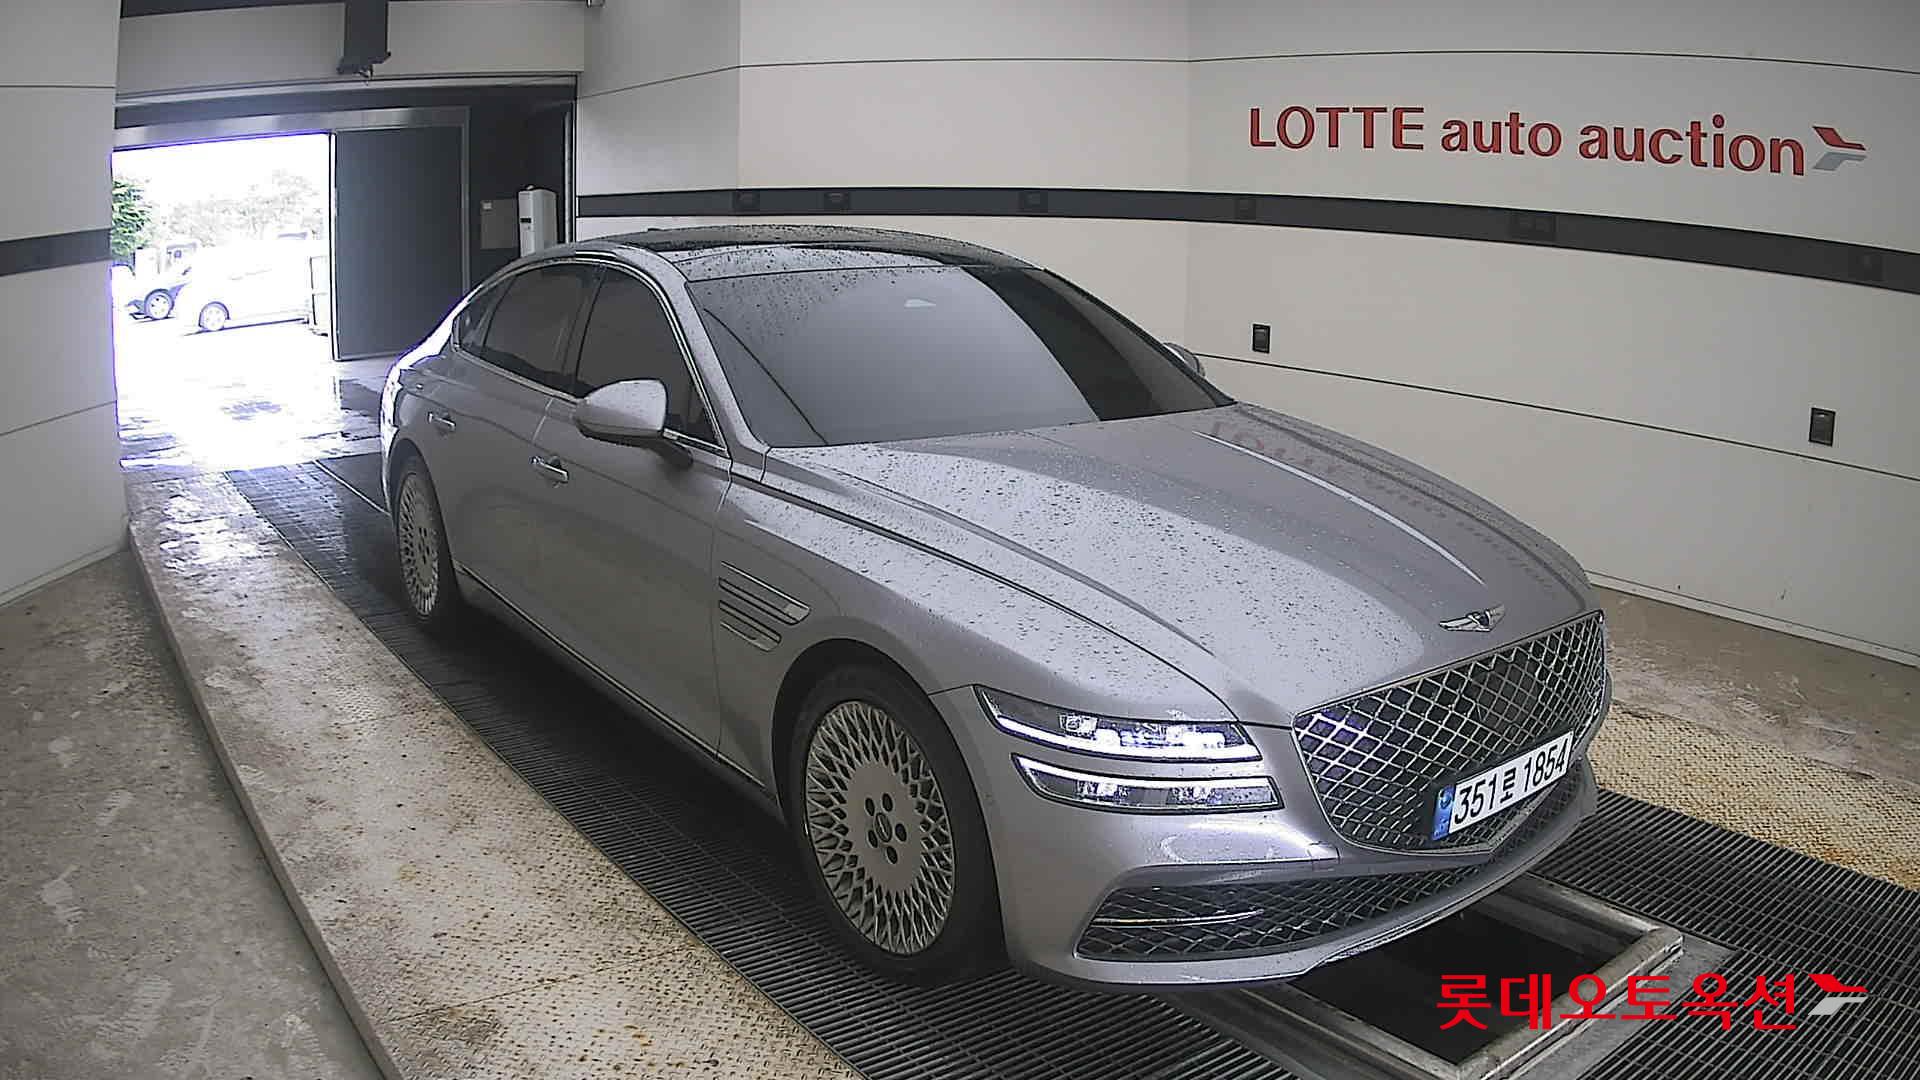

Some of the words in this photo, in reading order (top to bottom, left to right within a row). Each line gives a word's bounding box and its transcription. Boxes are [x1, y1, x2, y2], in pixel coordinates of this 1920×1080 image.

[1249, 106, 1424, 150] LOTTE
[1441, 111, 1562, 157] auto
[1579, 114, 1805, 176] auction
[1454, 767, 1516, 825] 351로
[1523, 738, 1569, 793] 1854
